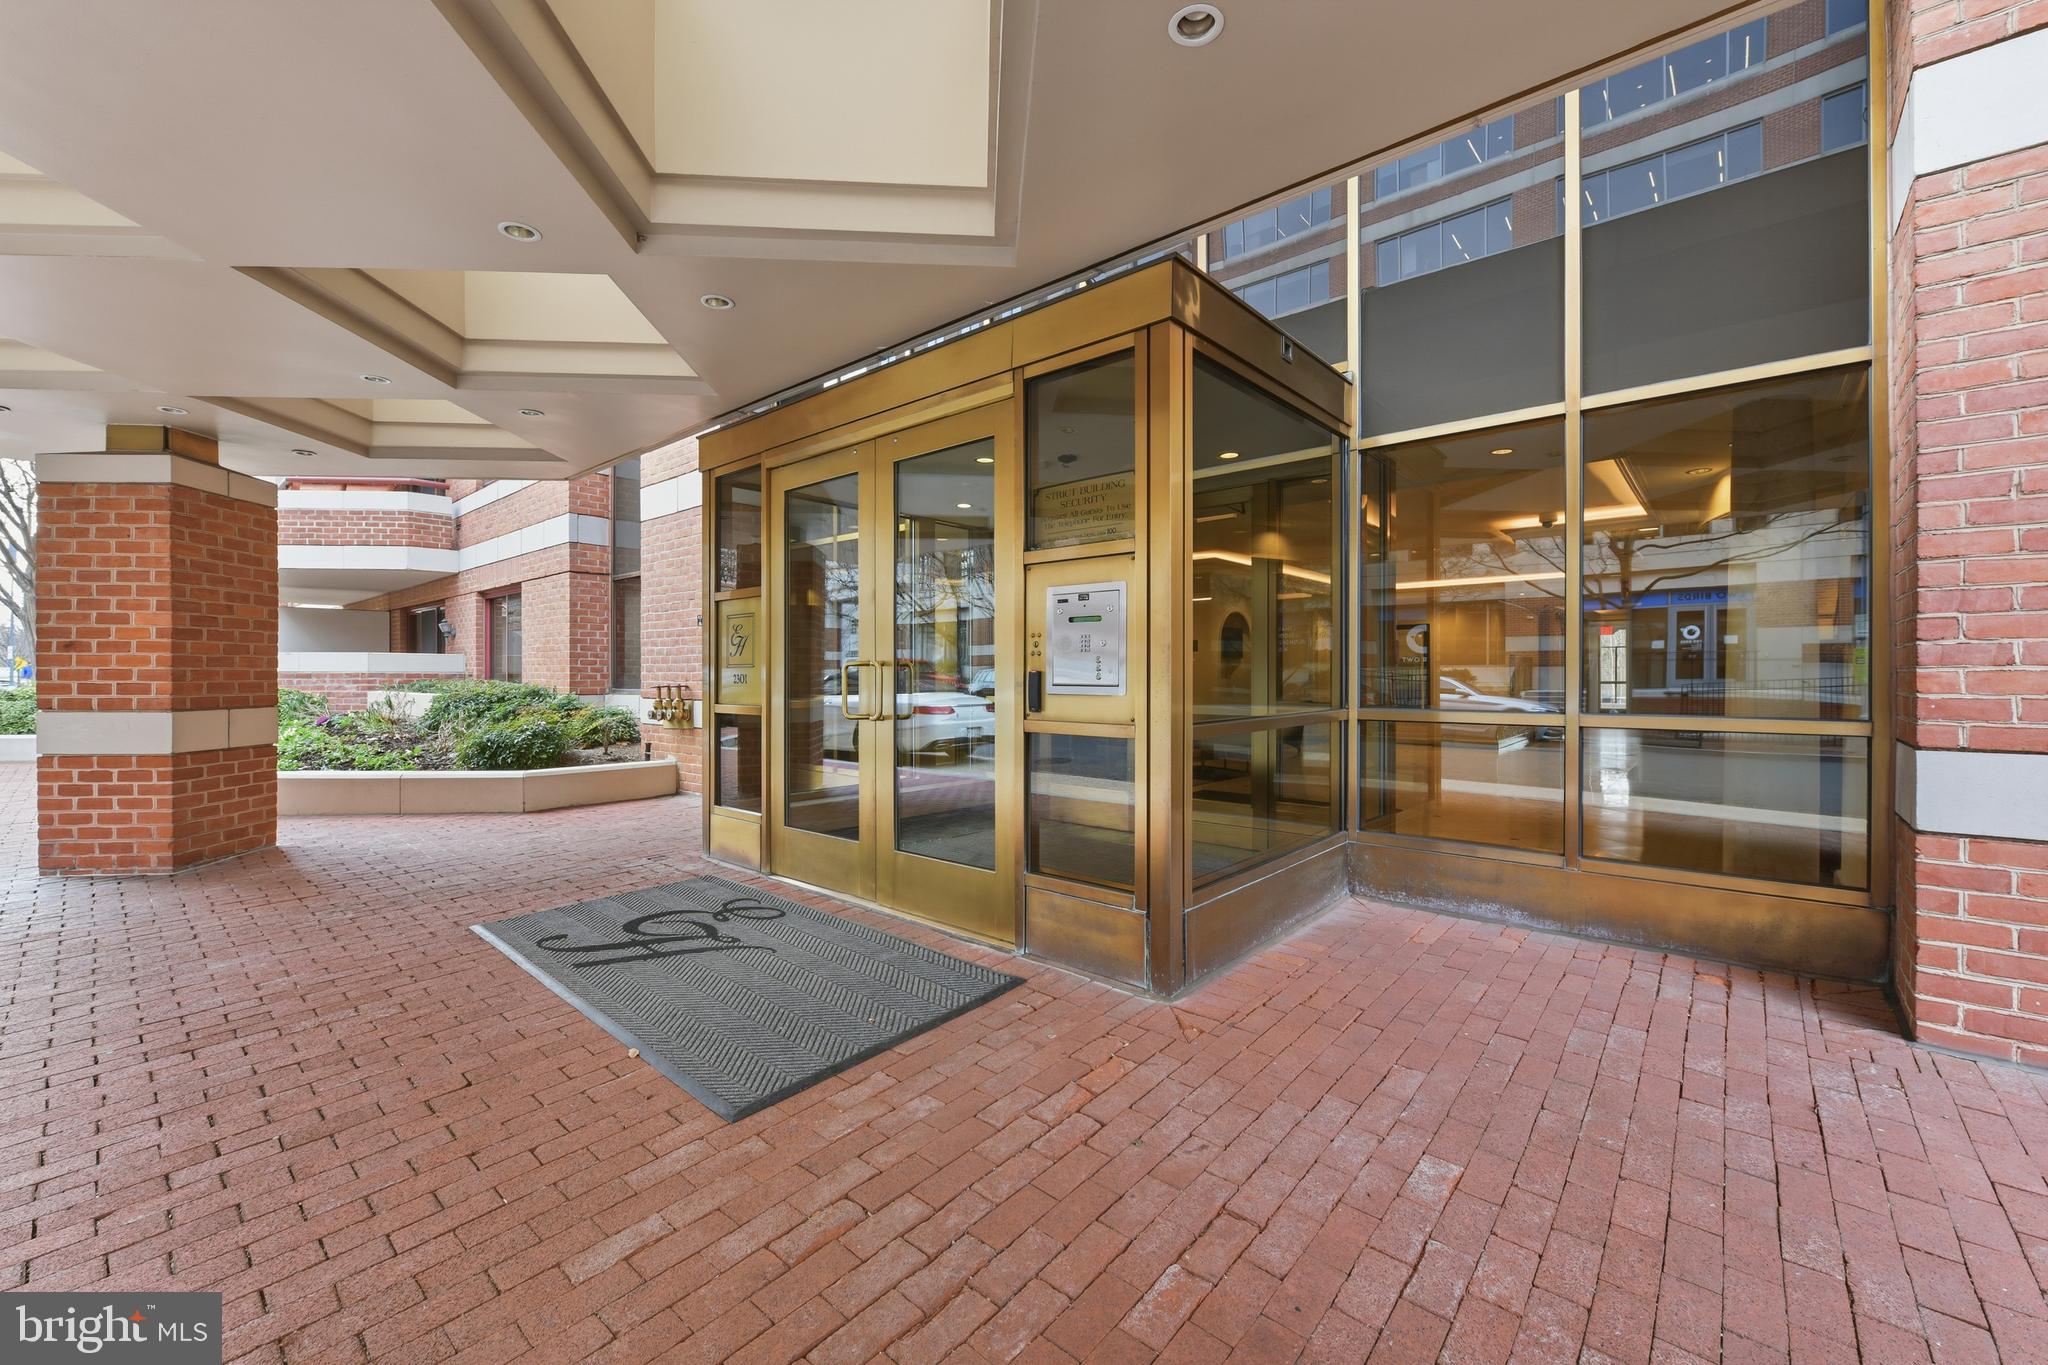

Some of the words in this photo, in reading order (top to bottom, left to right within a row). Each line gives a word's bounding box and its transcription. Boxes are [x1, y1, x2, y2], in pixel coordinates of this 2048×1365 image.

[1045, 488, 1076, 502] STRICT
[1079, 480, 1126, 495] BUILDING
[1060, 494, 1107, 508] SECURITY
[1106, 527, 1117, 535] 100
[733, 674, 747, 684] 2301
